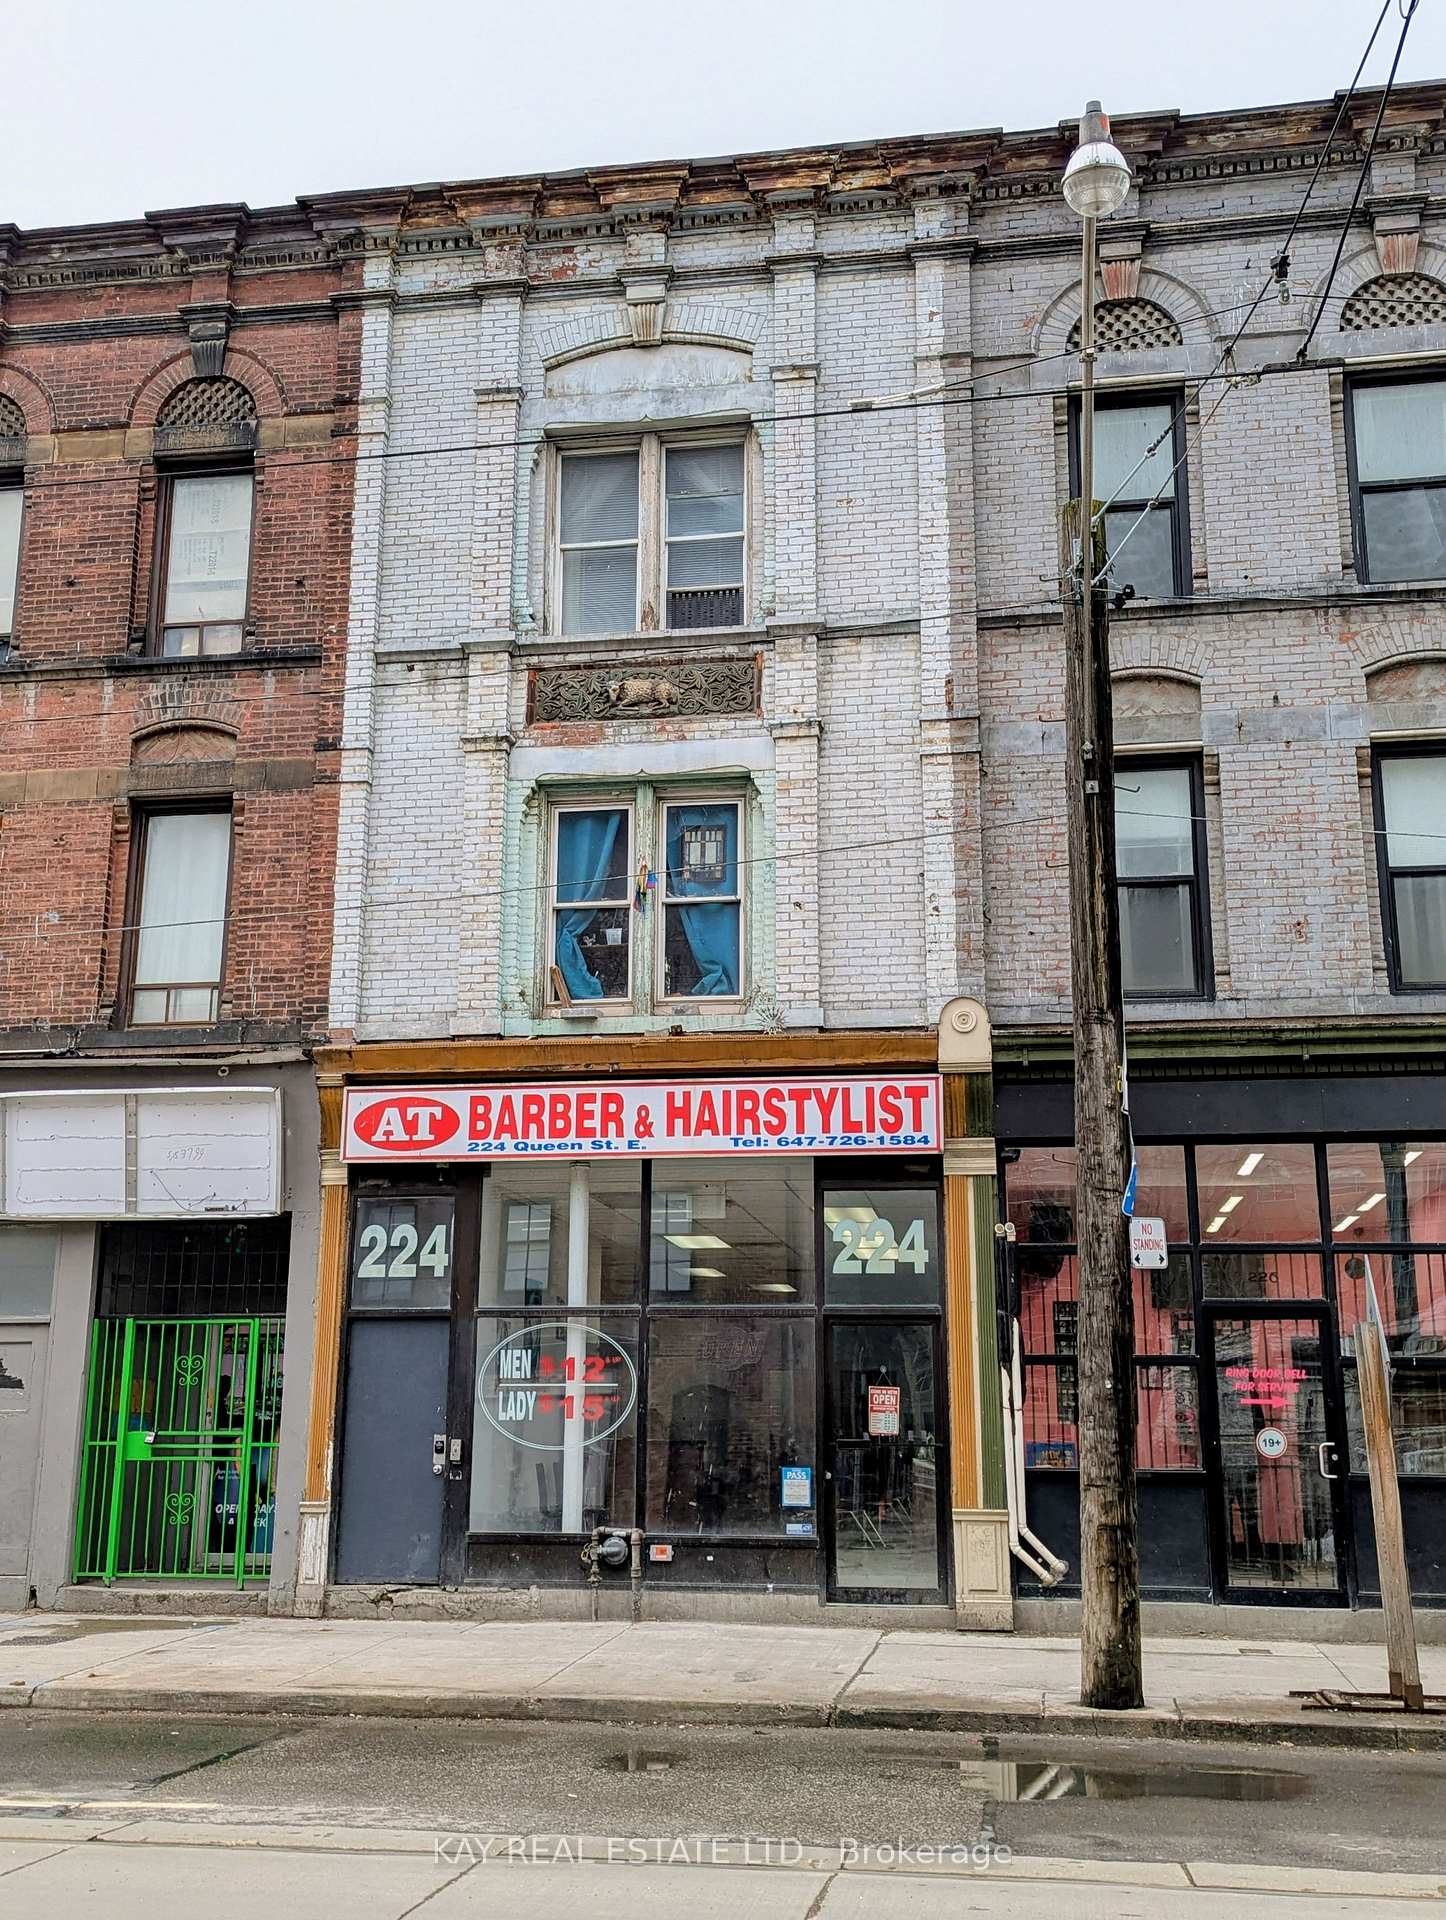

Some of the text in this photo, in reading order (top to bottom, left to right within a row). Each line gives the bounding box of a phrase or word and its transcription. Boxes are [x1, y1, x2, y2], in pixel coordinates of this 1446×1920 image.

[468, 1085, 929, 1141] BARBER & HAIRSTYLIST
[371, 1106, 443, 1142] AT
[467, 1140, 647, 1152] 224 Queen St. E.
[730, 1135, 930, 1147] Tel: 647-726-1584
[1141, 1223, 1153, 1236] NO
[357, 1223, 449, 1278] 224
[832, 1218, 929, 1274] 224
[1133, 1239, 1164, 1251] STANDING
[499, 1349, 532, 1379] MEN
[498, 1391, 537, 1421] LADY
[873, 1394, 896, 1405] OPEN
[1263, 1438, 1281, 1448] 19+
[786, 1471, 807, 1480] PASS
